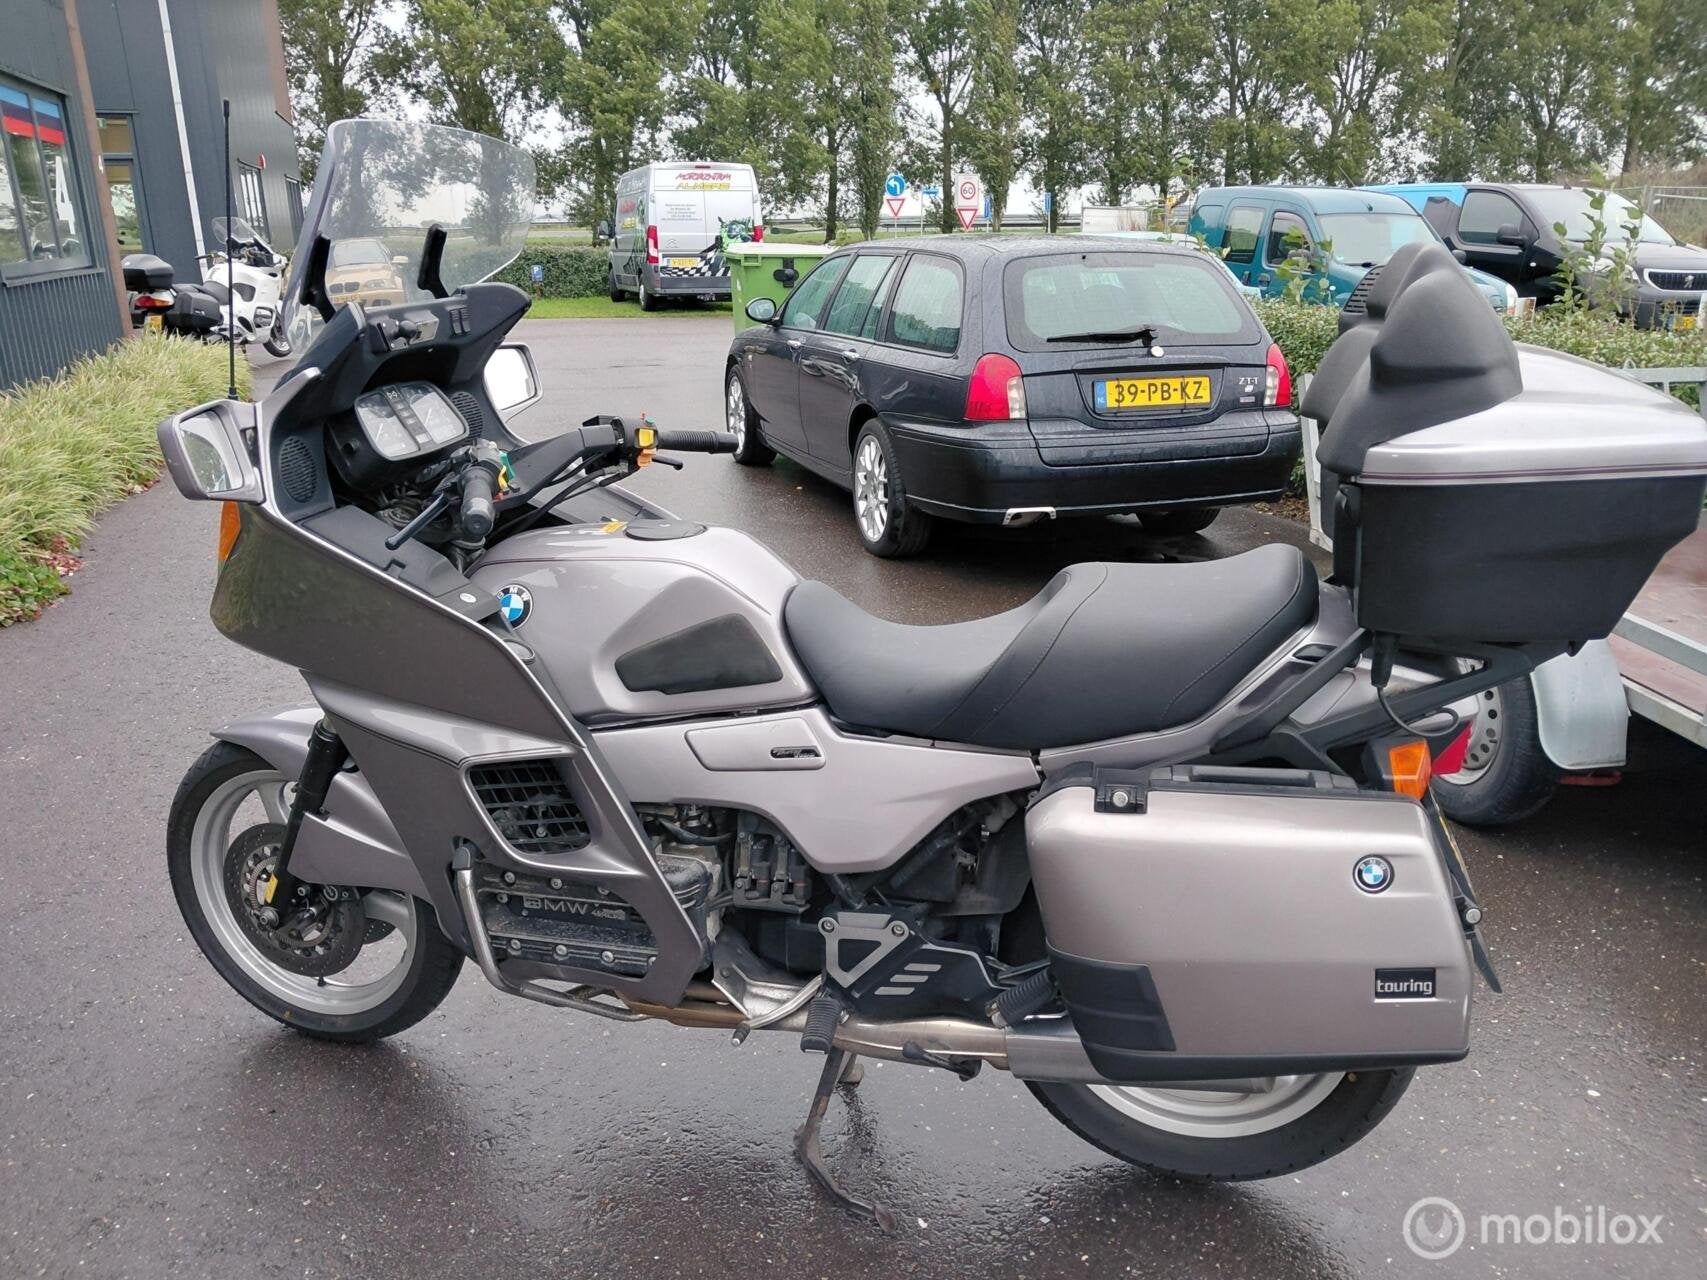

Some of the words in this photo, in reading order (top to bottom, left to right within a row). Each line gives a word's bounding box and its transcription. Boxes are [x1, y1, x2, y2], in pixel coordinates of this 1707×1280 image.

[963, 187, 973, 195] 60
[1114, 380, 1204, 404] 39-PB-KZ
[522, 895, 588, 916] BMW
[1375, 979, 1433, 995] touring
